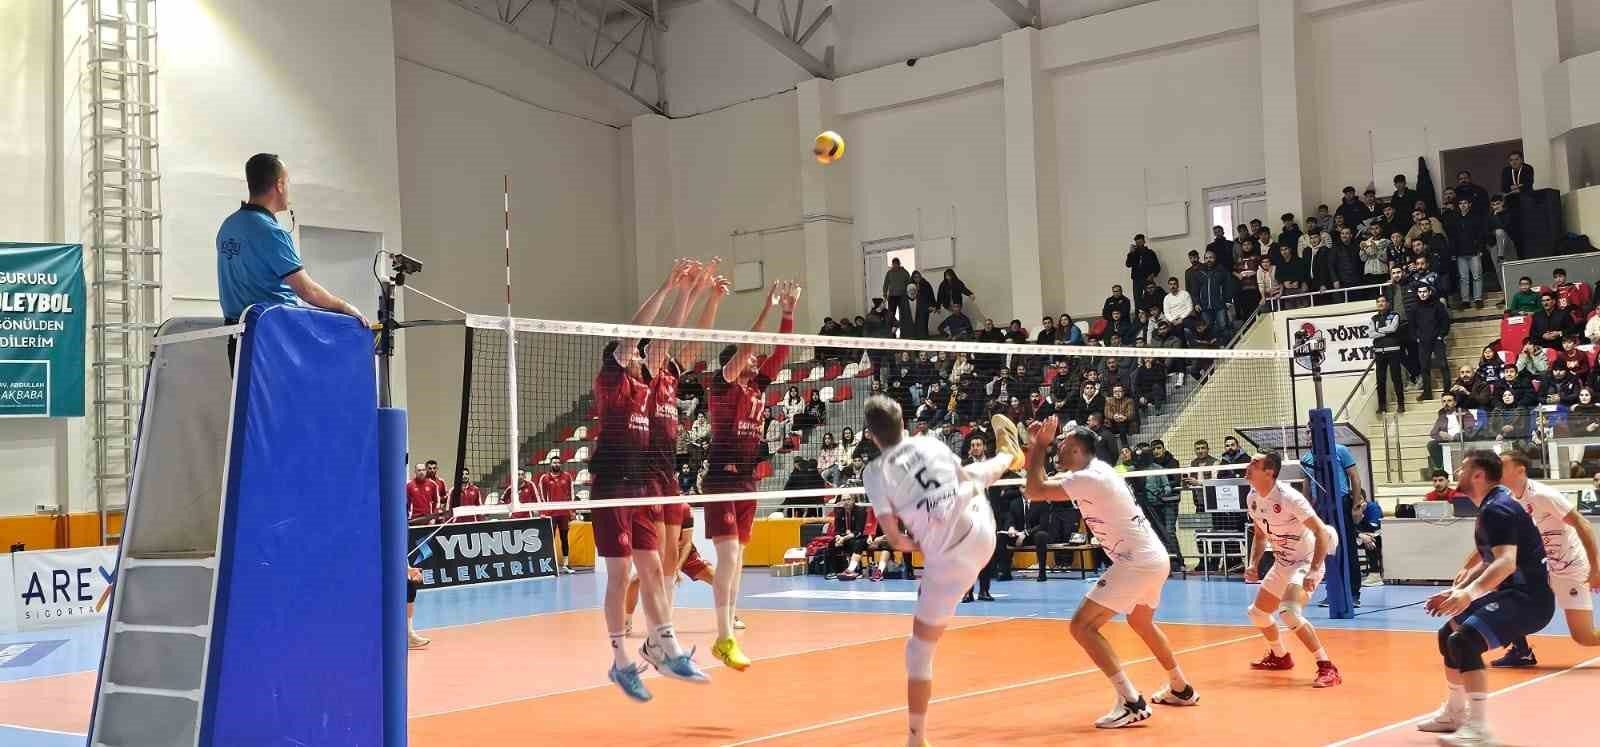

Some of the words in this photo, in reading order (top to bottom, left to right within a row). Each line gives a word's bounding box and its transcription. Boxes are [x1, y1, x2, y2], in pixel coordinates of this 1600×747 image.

[0, 292, 72, 313] LEYBOL
[0, 317, 64, 331] ÖNÜLDEN
[915, 466, 941, 489] 5
[436, 528, 543, 560] YUNUS
[422, 556, 554, 585] ELEKTRİK
